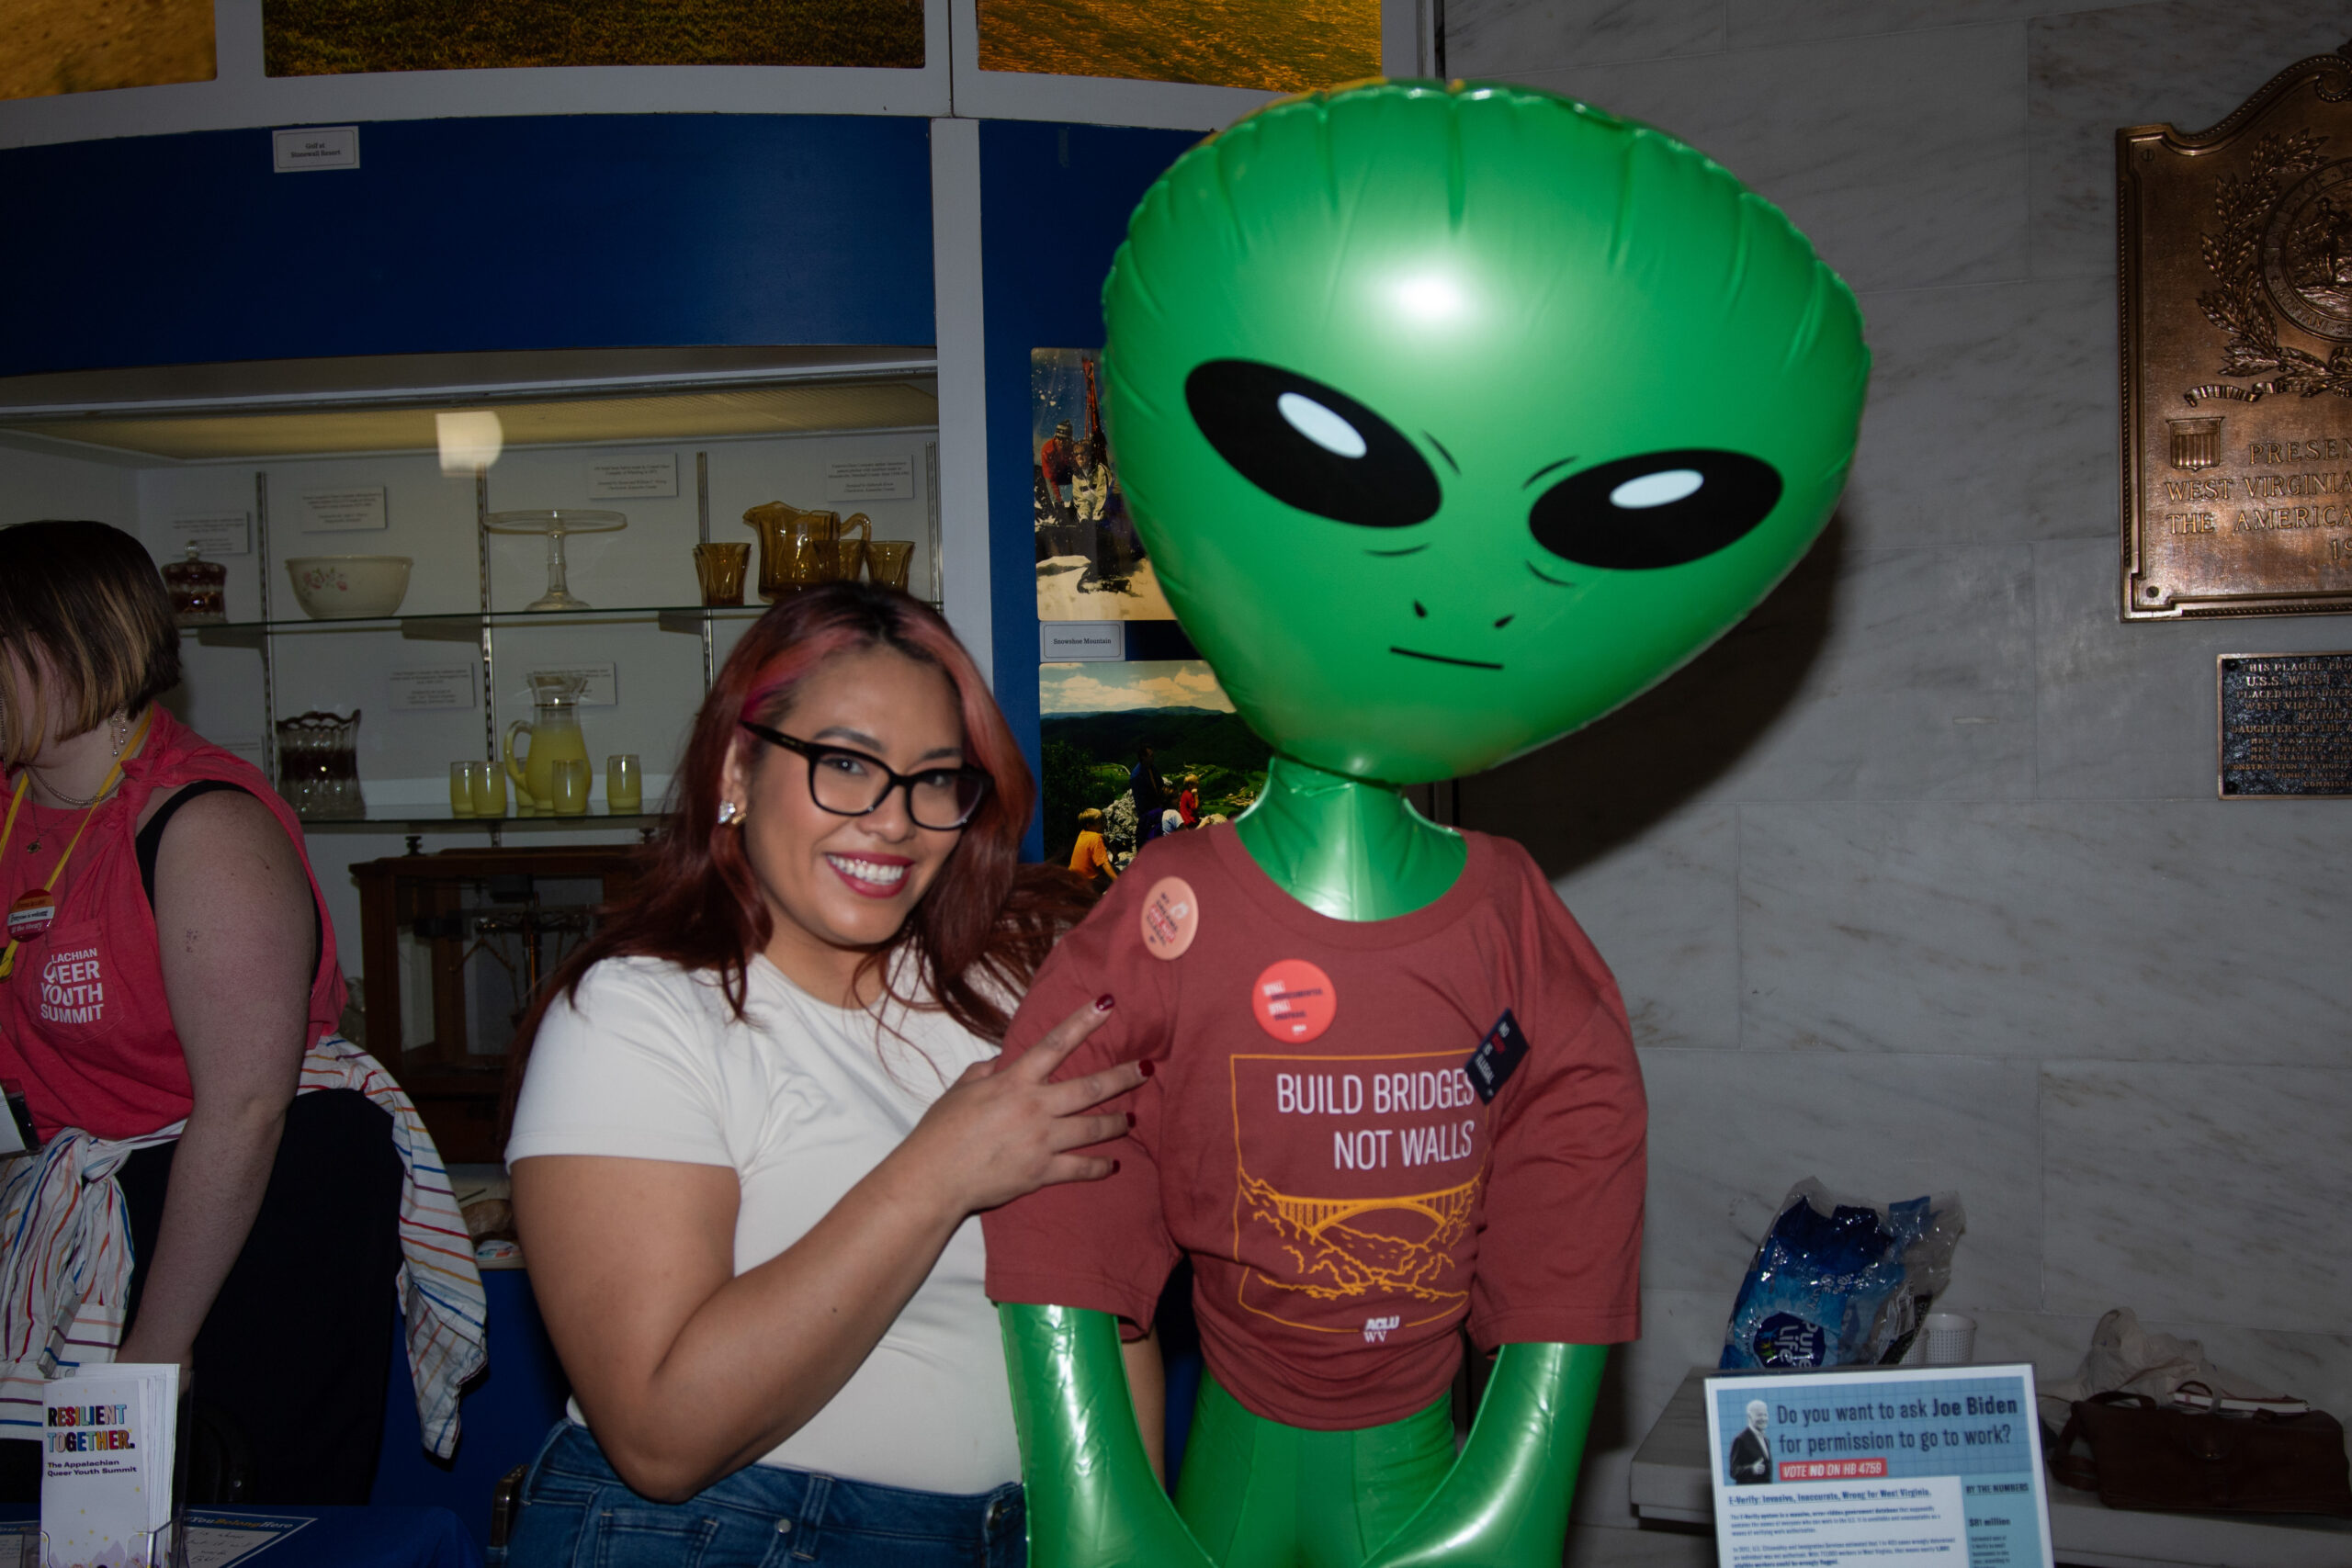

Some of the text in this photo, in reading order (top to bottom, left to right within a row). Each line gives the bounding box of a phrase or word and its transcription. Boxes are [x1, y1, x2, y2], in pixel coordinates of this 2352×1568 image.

[2165, 471, 2352, 502] WEST VIRGINIA
[2166, 512, 2215, 535] THE
[2242, 663, 2270, 672] THIS
[2274, 662, 2324, 672] PLAQUE
[2288, 674, 2334, 686] WEST
[2236, 689, 2282, 699] PLACED
[2285, 689, 2317, 698] HERE
[2245, 701, 2279, 711] WEST
[2285, 701, 2341, 710] VIRGINIA
[2231, 724, 2300, 733] DAUGHTERS
[2321, 724, 2343, 733] THE
[51, 947, 98, 964] LACHIAN
[40, 982, 104, 1007] YOUTH
[40, 1003, 106, 1024] SUMMIT
[1276, 1067, 1475, 1114] BUILD BRIDGES
[1334, 1120, 1474, 1170] NOT WALLS
[1363, 1314, 1399, 1331] ACLU
[1363, 1330, 1387, 1344] WV
[1773, 1325, 1799, 1364] Life
[47, 1404, 127, 1427] RESILIENT
[1777, 1396, 2018, 1427] Do you want to ask Joe Biden
[47, 1430, 136, 1453] TOGETHER.
[1779, 1424, 2012, 1457] for permission to go to work?
[64, 1459, 120, 1469] Appalachian
[1783, 1461, 1883, 1478] VOTE NO ON HB 4759
[1762, 1495, 1796, 1504] Invasive,
[1798, 1492, 1841, 1502] Inaccurate,
[1842, 1491, 1866, 1500] Wrong
[1867, 1490, 1878, 1498] for
[1880, 1489, 1898, 1498] West
[1900, 1488, 1931, 1498] Virginia.
[1966, 1483, 2029, 1494] BY THE NUMBERS
[1969, 1517, 2011, 1527] $81 million
